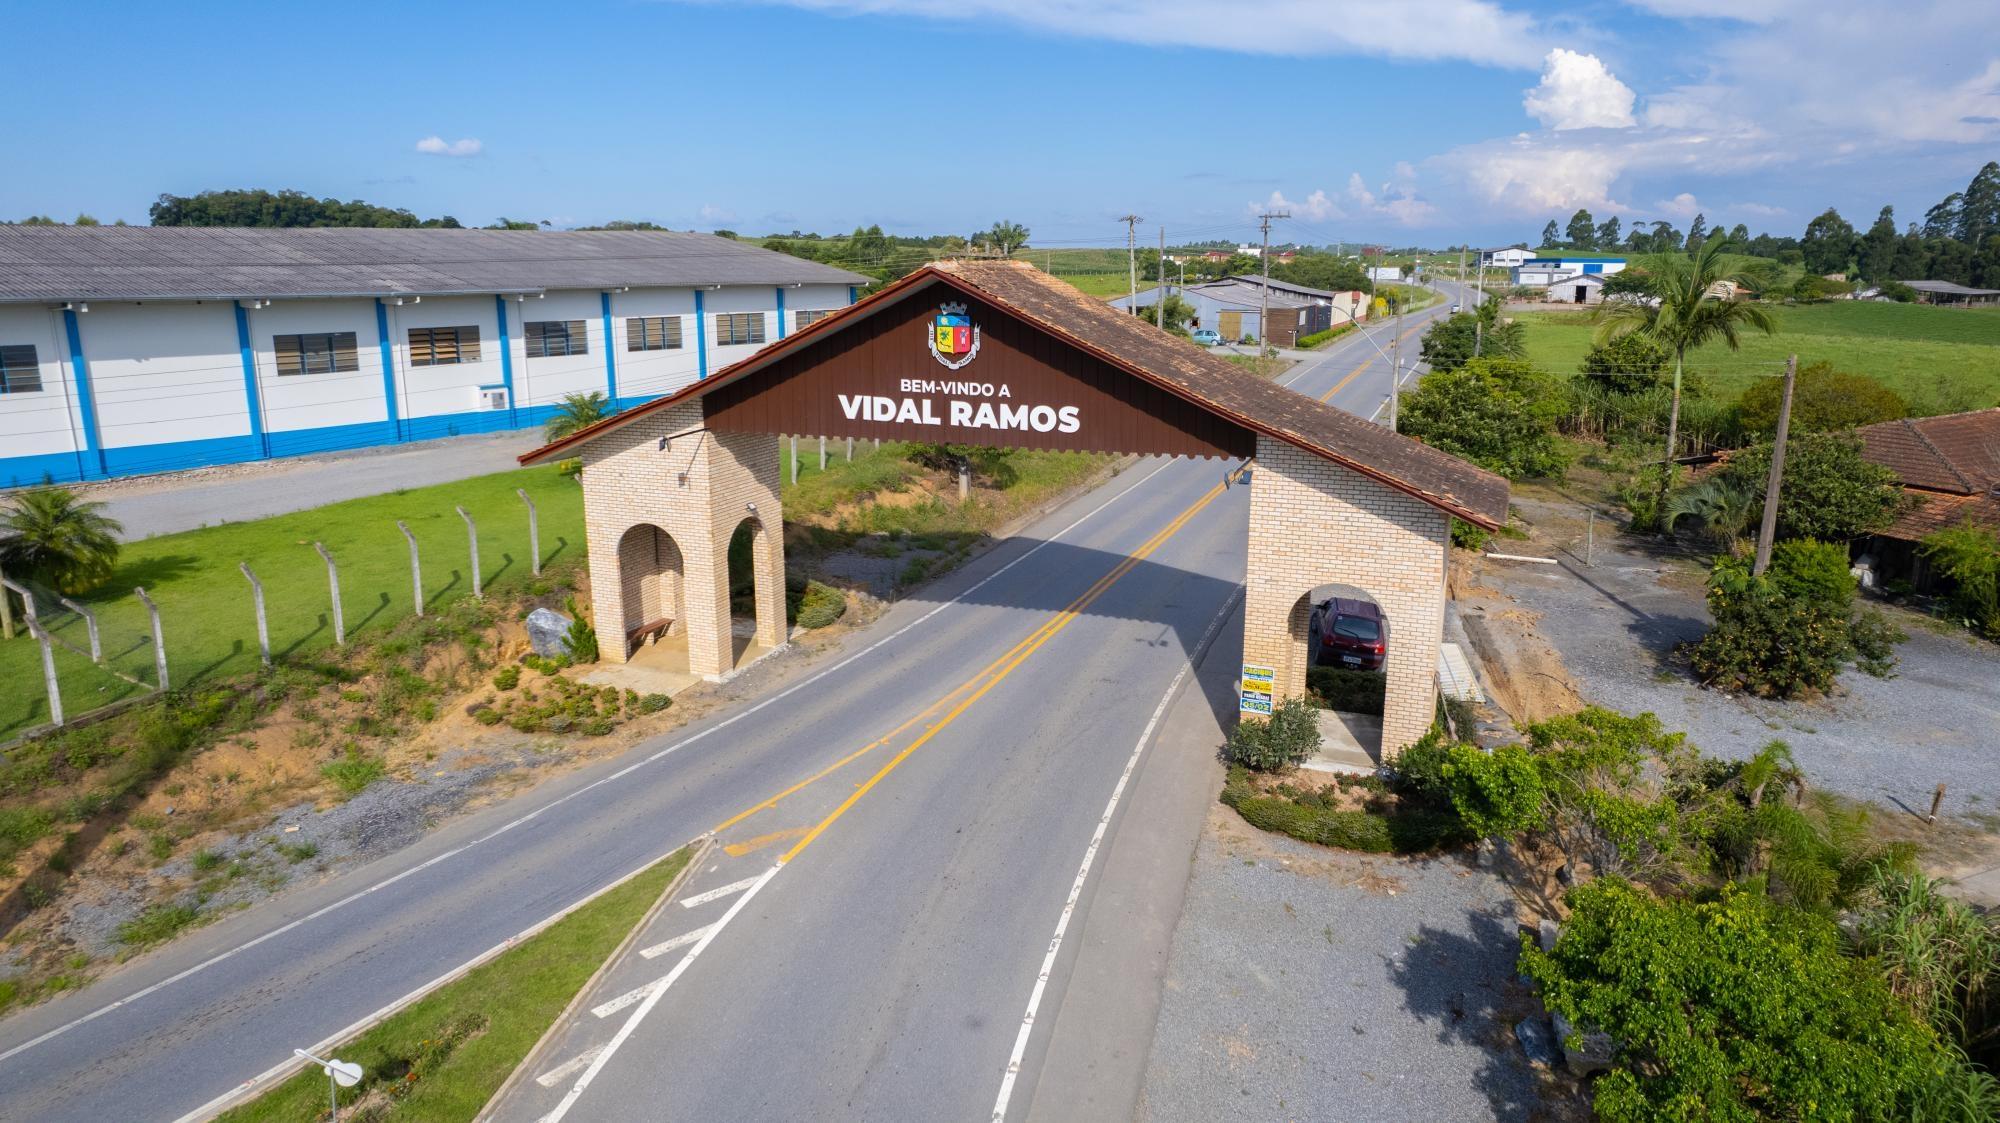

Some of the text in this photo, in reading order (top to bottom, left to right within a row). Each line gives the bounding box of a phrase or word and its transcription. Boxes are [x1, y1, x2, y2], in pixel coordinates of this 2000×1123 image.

[901, 379, 1011, 397] BEM-VINDO A
[838, 395, 1080, 433] VIDAL RAMOS
